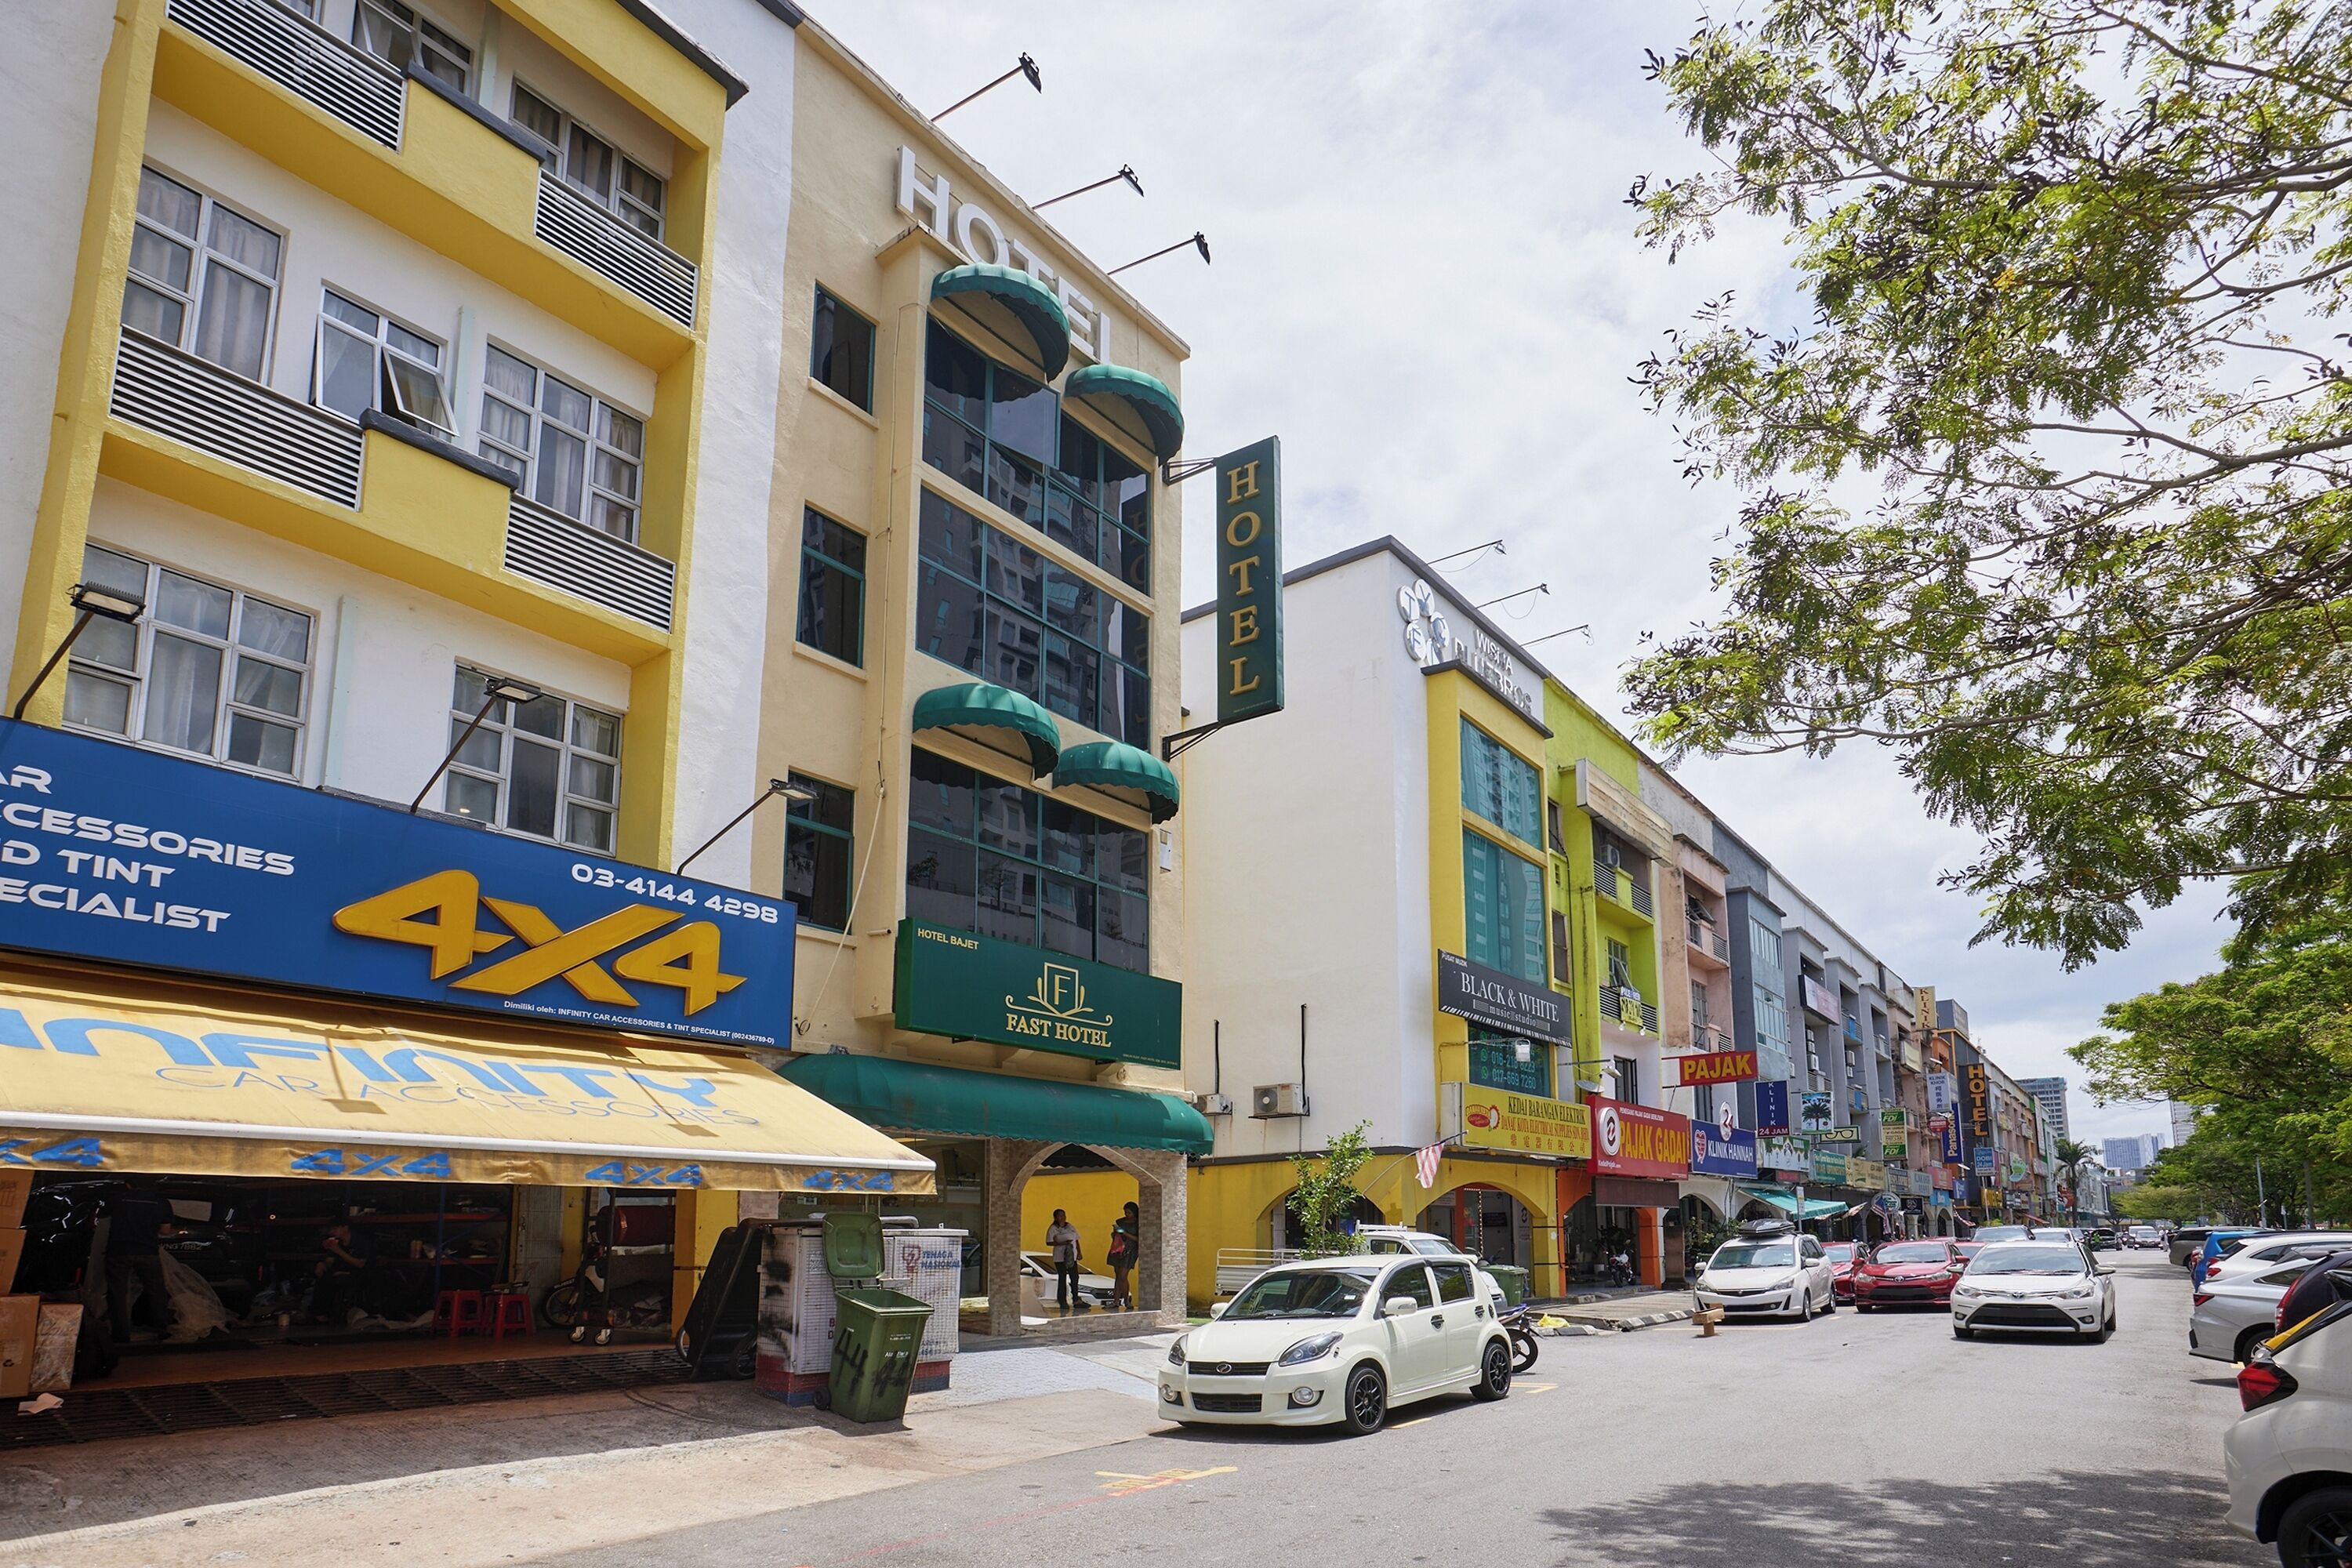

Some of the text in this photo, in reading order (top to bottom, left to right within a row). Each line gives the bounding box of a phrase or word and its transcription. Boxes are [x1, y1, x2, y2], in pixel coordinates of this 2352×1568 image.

[1226, 459, 1261, 696] HOTEL
[0, 765, 53, 794] R
[0, 799, 295, 876] CESSORIES
[56, 849, 176, 887] TINT
[0, 877, 231, 932] ECIALIST
[572, 863, 778, 924] 03-4144 4298
[917, 928, 979, 950] HOTEL BAJET
[1054, 974, 1071, 1005] F
[1461, 971, 1559, 1022] BLACK & WHITE
[1919, 988, 1930, 1029] KLINIK
[504, 1000, 535, 1011] Dimiliki
[536, 1005, 557, 1014] oleh:
[558, 1008, 592, 1018] INFINITY
[612, 1015, 665, 1029] ACCESSORIES
[691, 1026, 731, 1037] SPECIALIST
[1006, 1013, 1112, 1047] FAST HOTEL
[1490, 1005, 1537, 1027] music studio
[1683, 1054, 1753, 1080] PAJAK
[156, 1067, 759, 1126] CAR ACCESSORIES
[1508, 1096, 1527, 1116] KEDAI
[1528, 1099, 1559, 1120] BARANGAN
[1768, 1083, 1777, 1126] KLINIK
[1968, 1064, 1989, 1136] HOTEL
[1619, 1120, 1686, 1164] PAJAK GADAI
[1708, 1139, 1754, 1163] KLINIK HANNAH
[1947, 1109, 1958, 1157] Panasonc
[920, 1260, 960, 1269] NASIONAL
